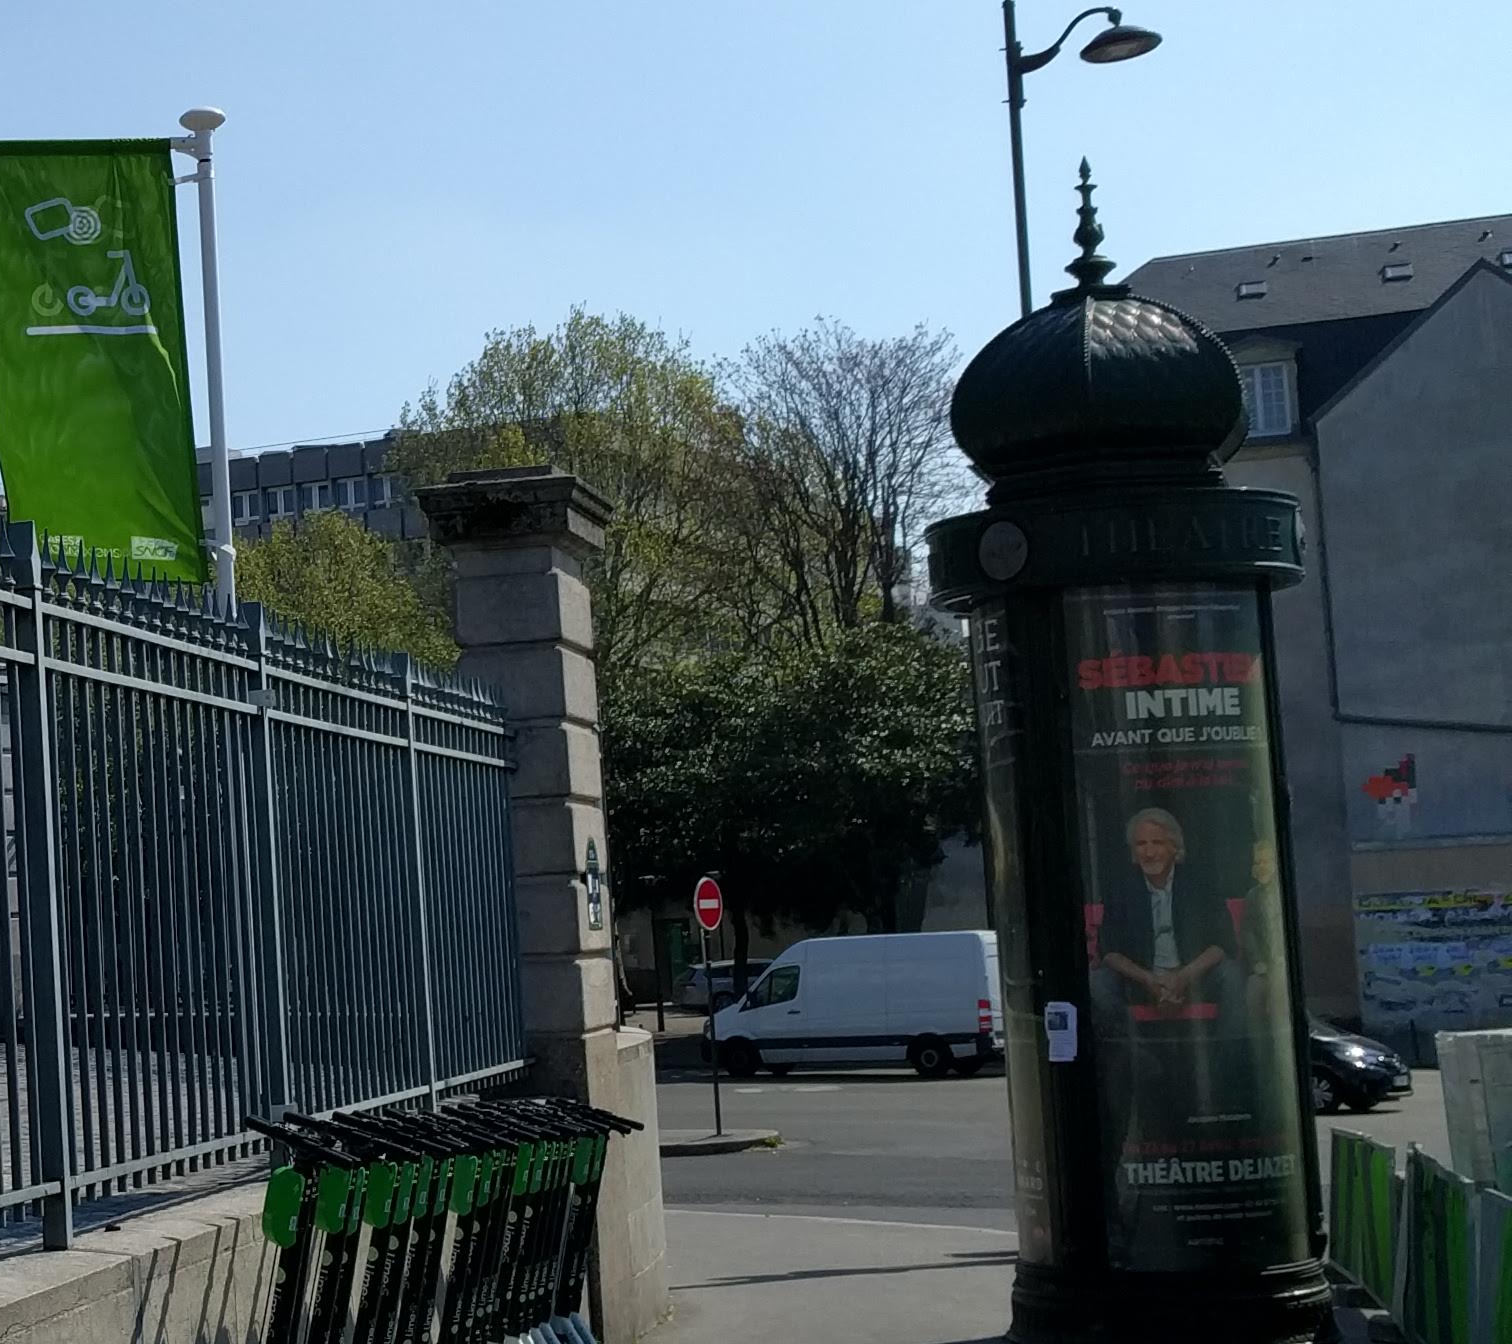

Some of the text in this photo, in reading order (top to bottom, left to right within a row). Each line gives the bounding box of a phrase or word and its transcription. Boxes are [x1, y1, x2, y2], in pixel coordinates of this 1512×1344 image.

[134, 544, 175, 558] SNCF
[1125, 687, 1241, 720] INTIME
[1090, 730, 1154, 748] AVANT
[1157, 727, 1196, 744] QUE
[1123, 1157, 1225, 1185] THÉÂTRE
